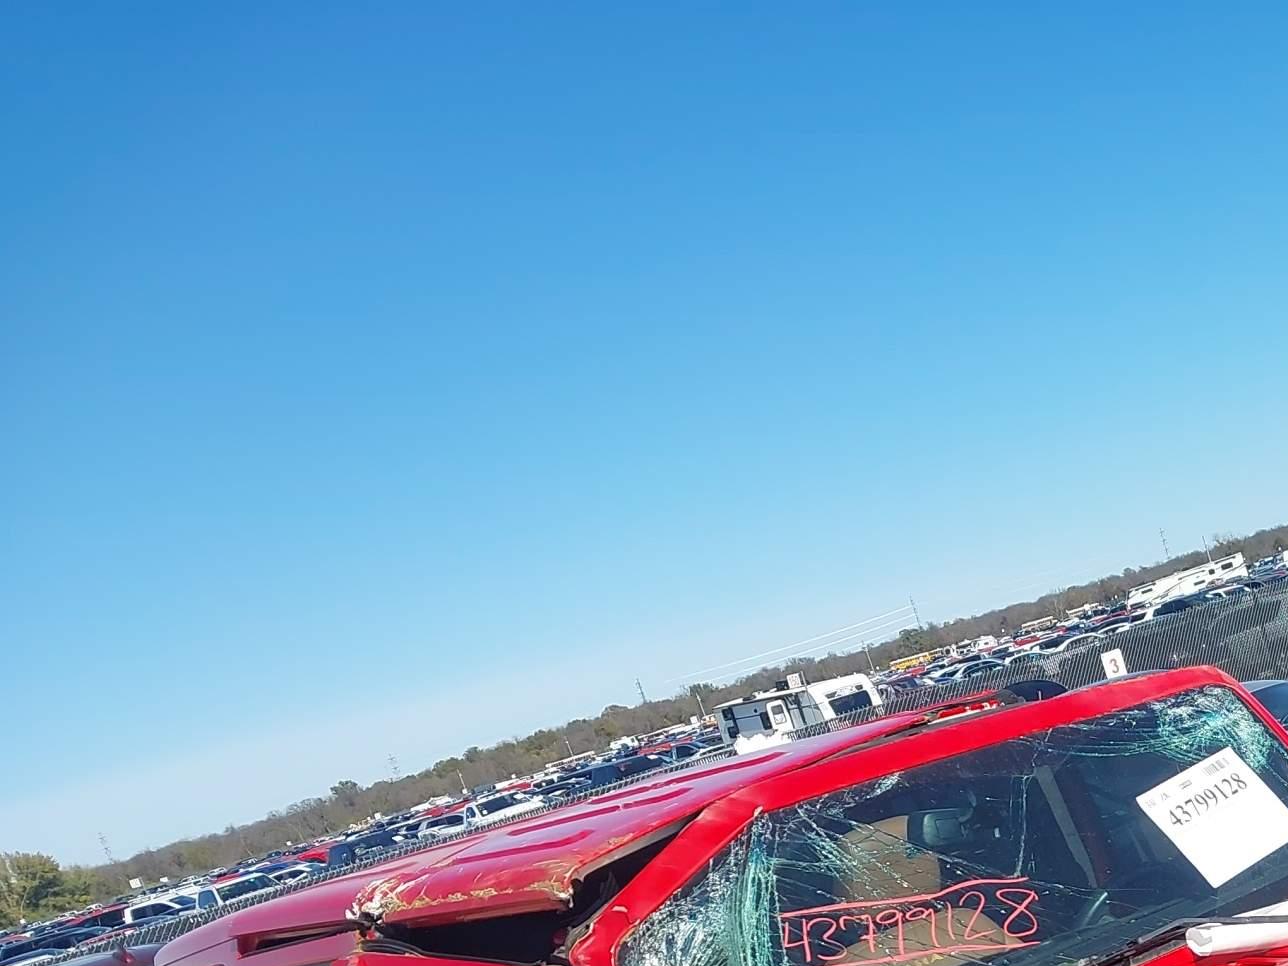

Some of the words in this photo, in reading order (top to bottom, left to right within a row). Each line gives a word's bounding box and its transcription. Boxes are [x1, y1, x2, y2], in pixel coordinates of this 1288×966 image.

[1109, 658, 1120, 673] 3
[1169, 772, 1248, 827] 43799128
[783, 888, 1040, 963] 43799128
